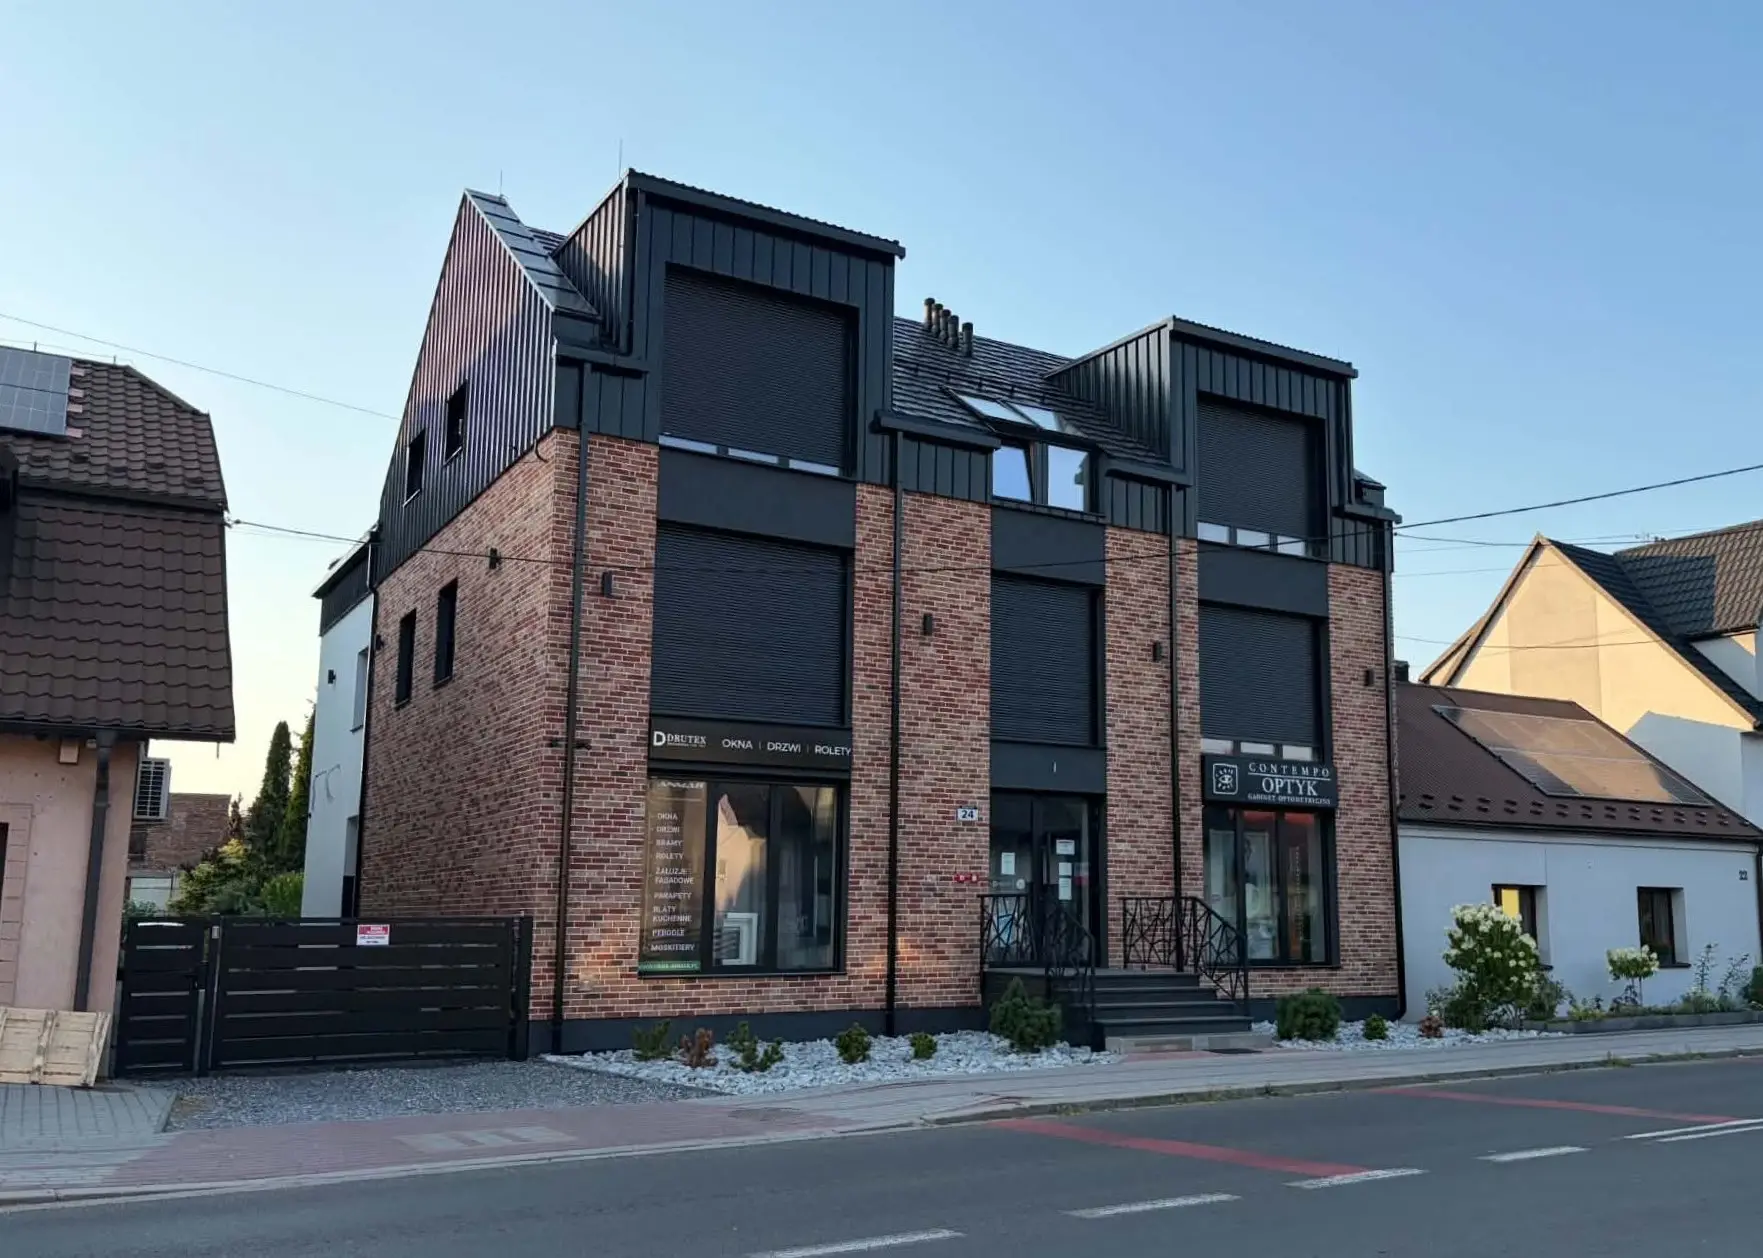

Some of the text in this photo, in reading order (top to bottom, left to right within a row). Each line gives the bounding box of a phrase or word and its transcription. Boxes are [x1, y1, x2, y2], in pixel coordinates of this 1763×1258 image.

[667, 733, 707, 745] DRUTEX
[722, 738, 851, 756] OKNA DRZWI ROLETY
[1248, 762, 1330, 777] CONTEMPO
[1262, 777, 1318, 796] OPTYK
[657, 812, 678, 820] OKNA
[961, 809, 974, 819] 24
[655, 852, 684, 860] ROLETY
[653, 892, 692, 900] PARAPETY
[653, 905, 676, 913] BLATY
